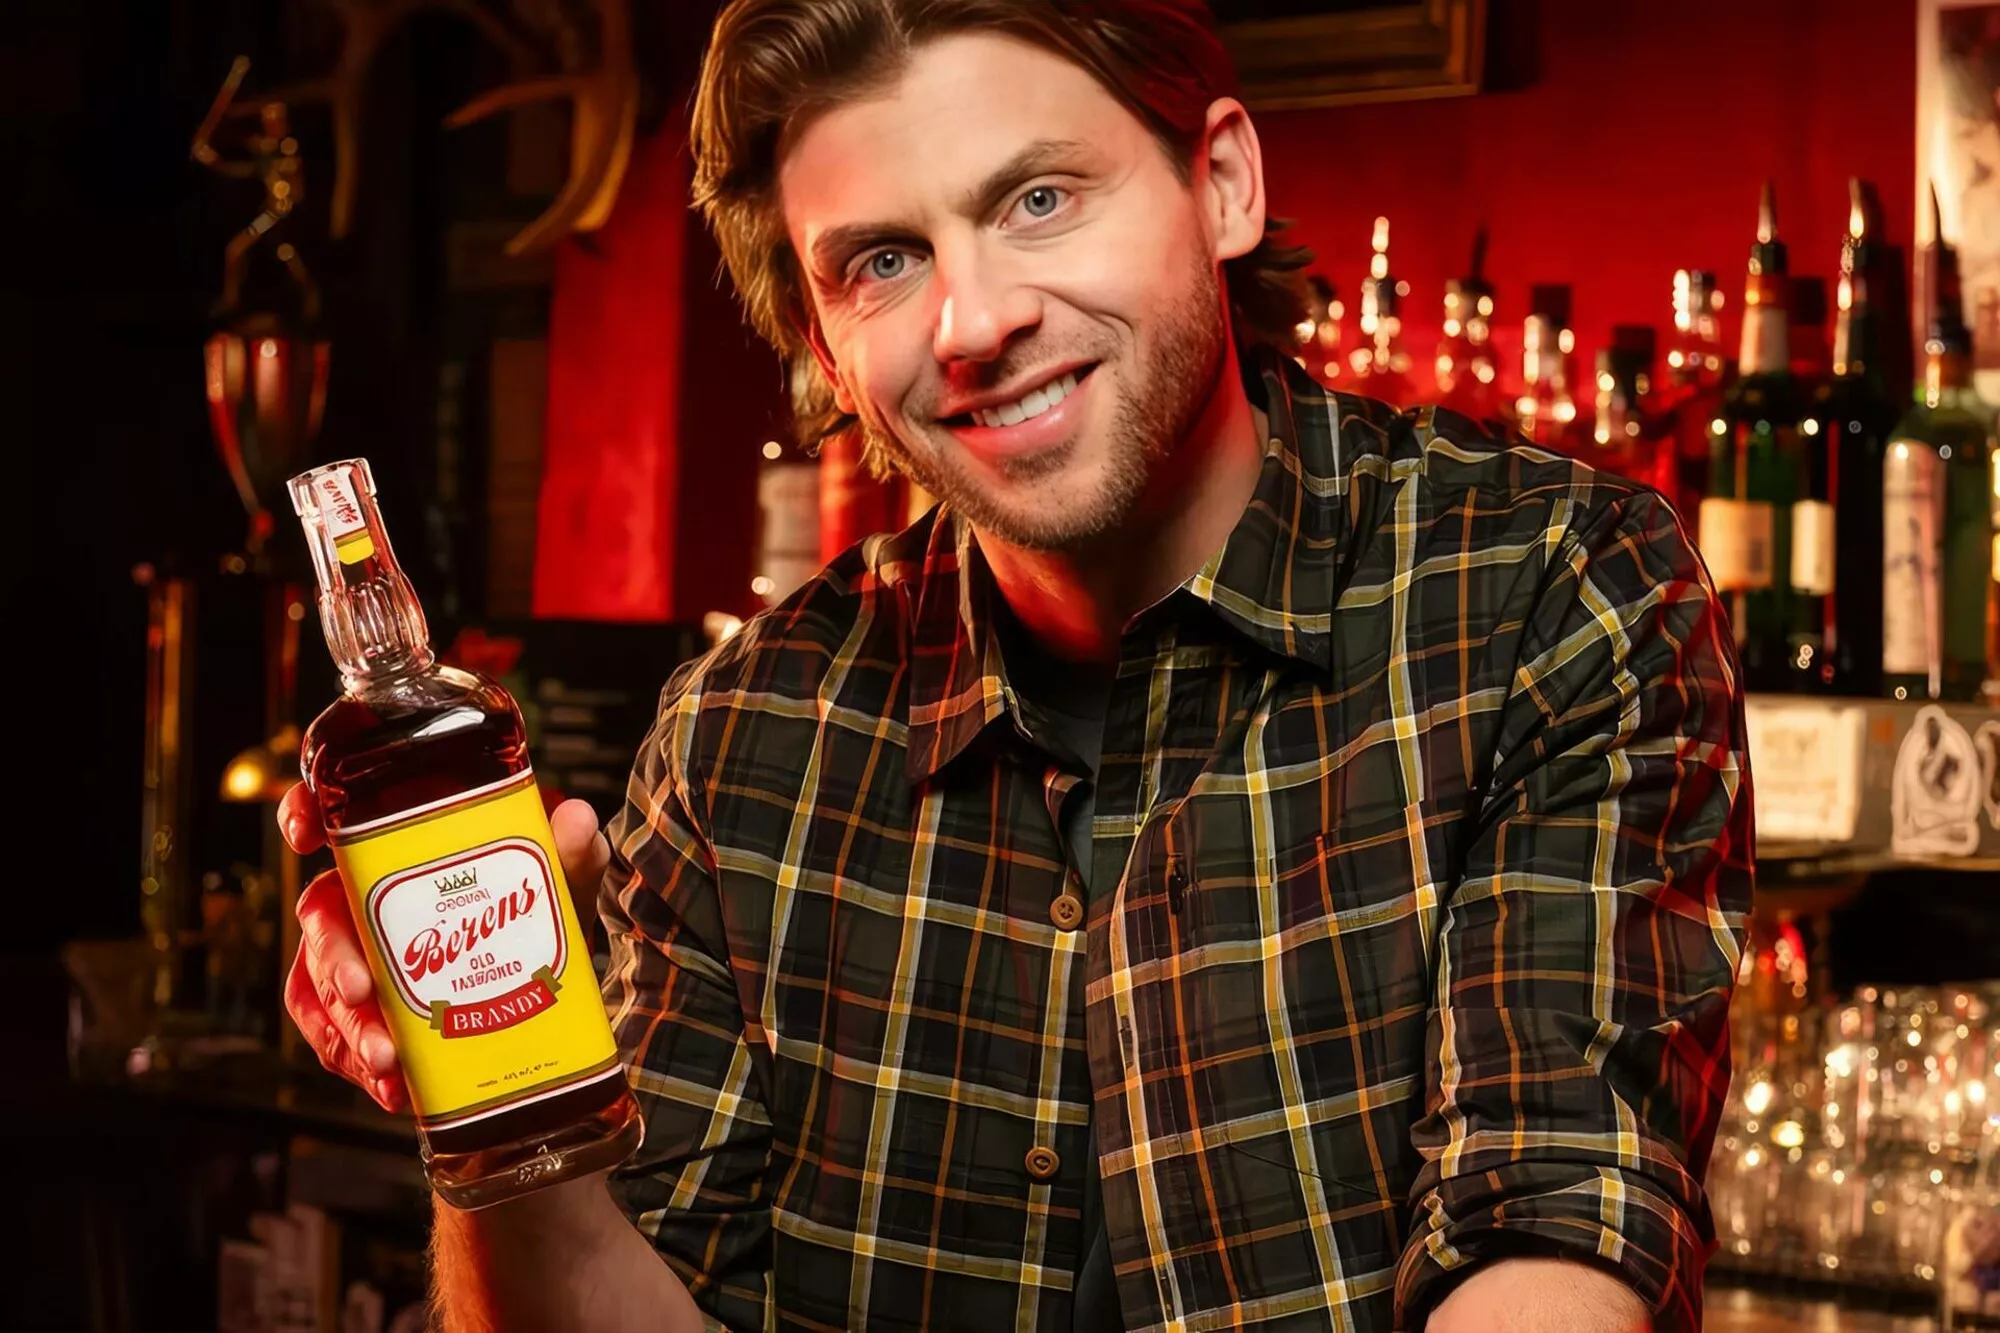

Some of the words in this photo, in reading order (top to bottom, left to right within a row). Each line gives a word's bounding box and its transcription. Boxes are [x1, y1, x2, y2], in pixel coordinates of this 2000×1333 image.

[403, 877, 538, 982] Berens
[470, 952, 496, 970] OLD
[453, 985, 542, 1031] BRANDY
